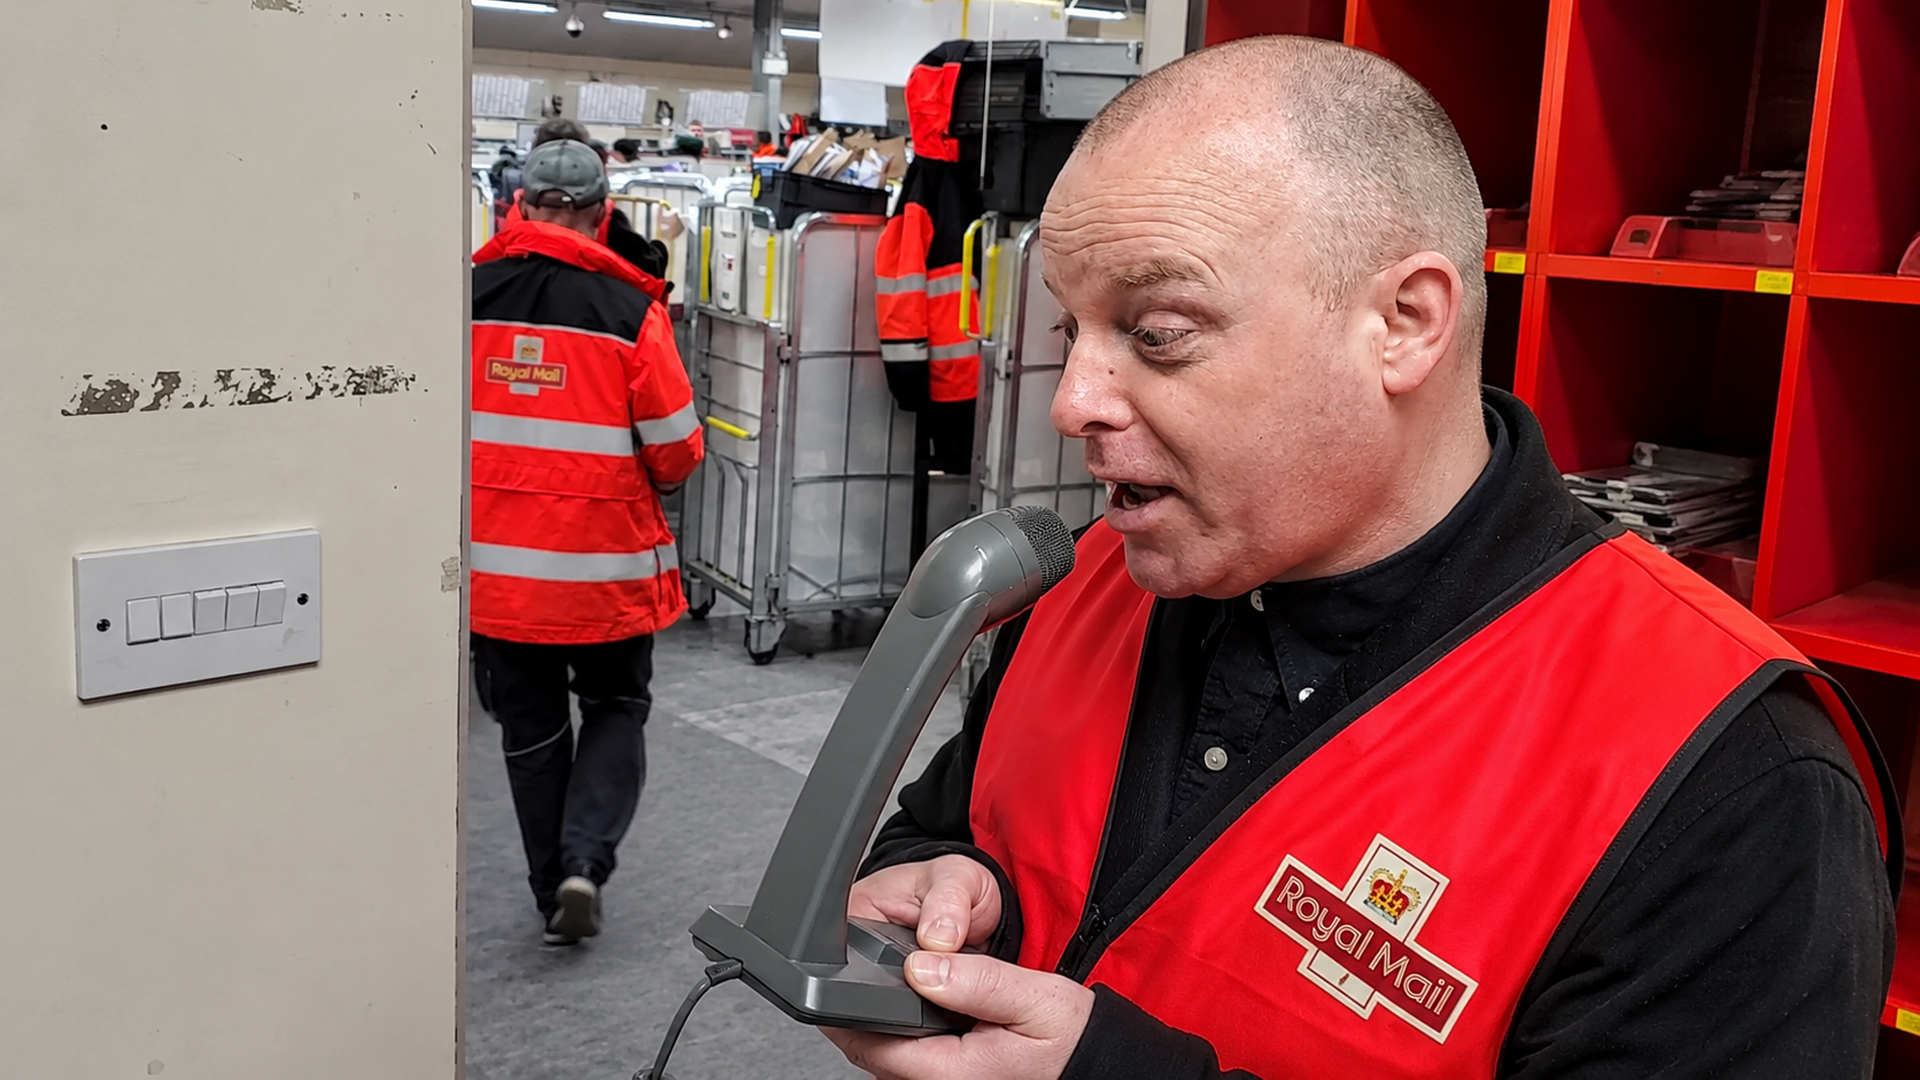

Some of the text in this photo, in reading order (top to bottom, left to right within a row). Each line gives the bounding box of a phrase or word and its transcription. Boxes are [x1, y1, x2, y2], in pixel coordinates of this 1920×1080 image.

[491, 362, 561, 382] Royal Mail
[1276, 875, 1454, 1015] Royal Mail
